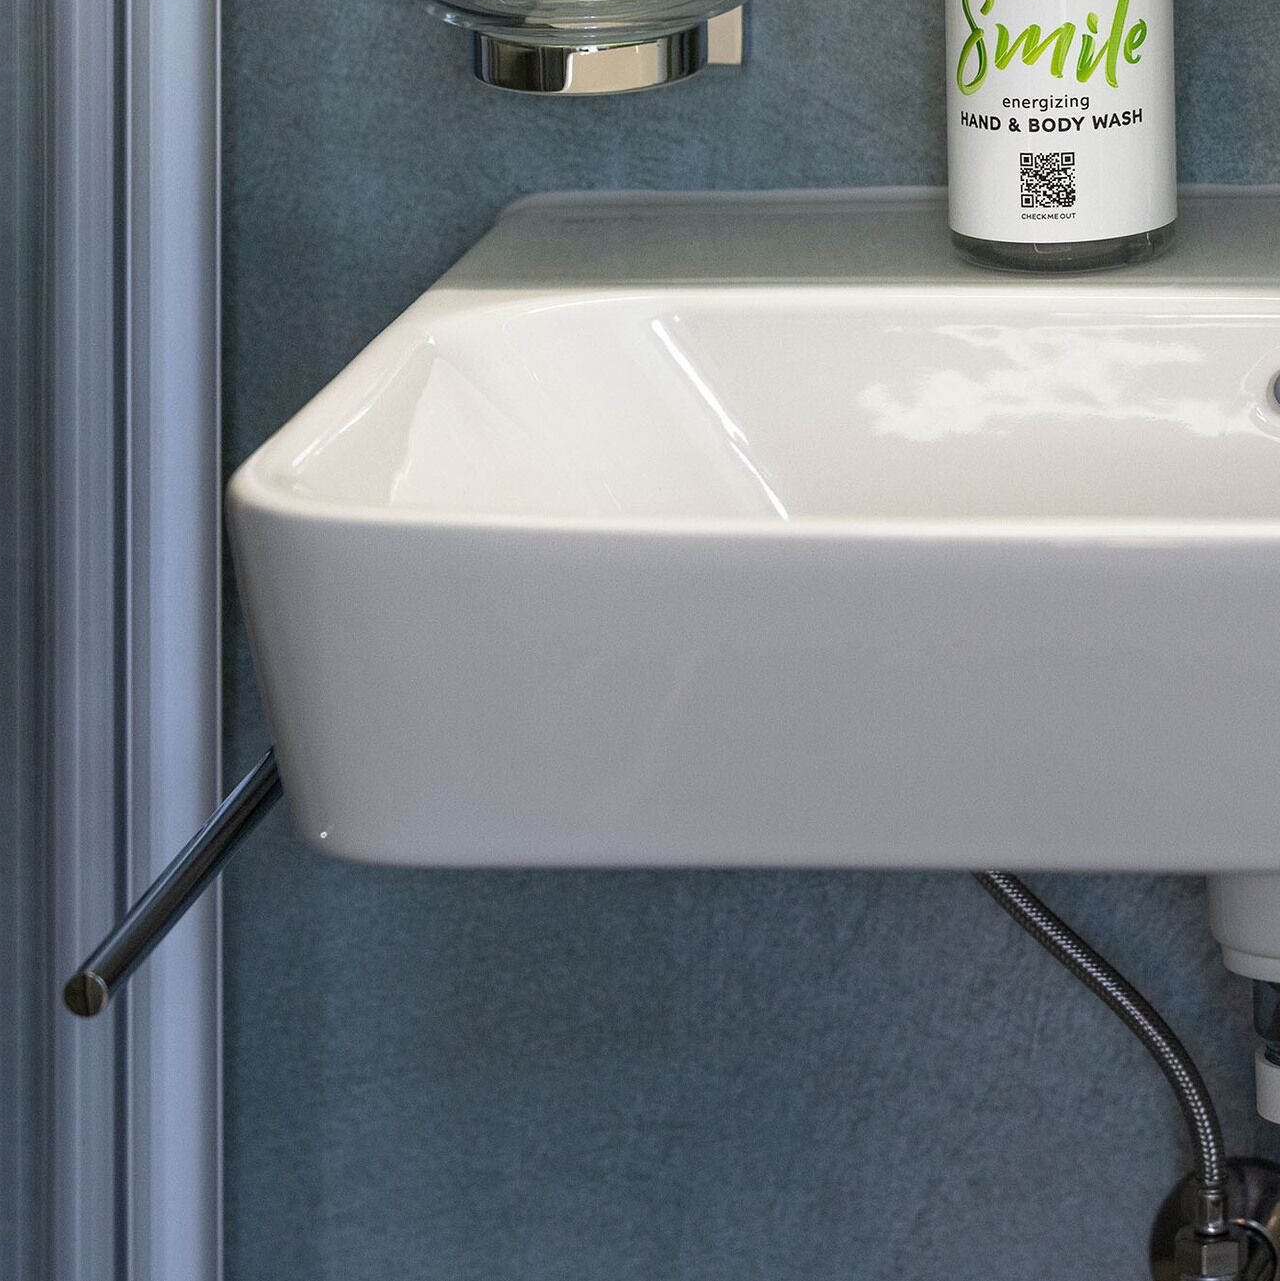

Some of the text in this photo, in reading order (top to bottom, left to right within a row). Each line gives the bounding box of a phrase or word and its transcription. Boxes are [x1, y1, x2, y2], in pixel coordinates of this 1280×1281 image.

[1002, 94, 1090, 111] energizing
[960, 108, 1143, 133] HAND & BODY WASH
[1021, 212, 1076, 220] CHECK ME OUT
